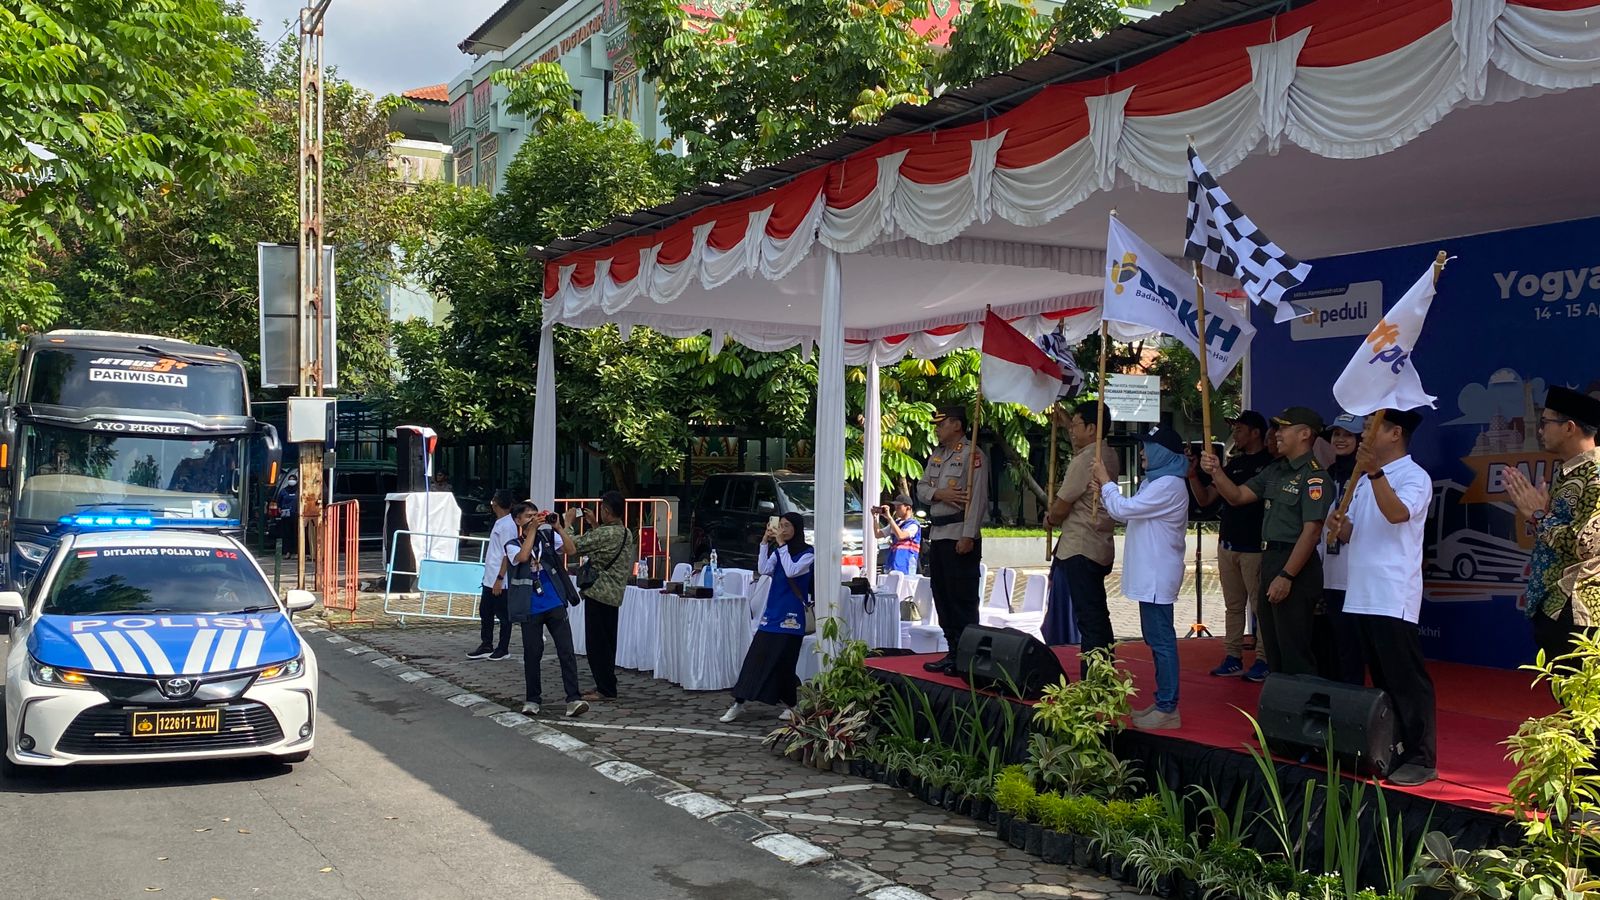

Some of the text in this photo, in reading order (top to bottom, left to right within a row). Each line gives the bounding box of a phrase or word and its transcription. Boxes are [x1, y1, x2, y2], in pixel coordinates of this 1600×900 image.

[1135, 289, 1160, 304] Badan
[1534, 307, 1551, 320] 14
[1566, 304, 1581, 317] 15
[1586, 302, 1600, 317] A
[90, 358, 157, 367] JETBUS
[1213, 351, 1229, 363] Haji
[94, 370, 184, 385] PARIWISATA
[93, 422, 125, 431] AYO
[129, 424, 179, 434] PIKNIK
[103, 548, 158, 557] DITLANTAS
[160, 549, 193, 557] POLDA
[215, 550, 238, 560] 612
[71, 617, 265, 632] POLISI
[160, 715, 216, 730] 122611-XXIV
